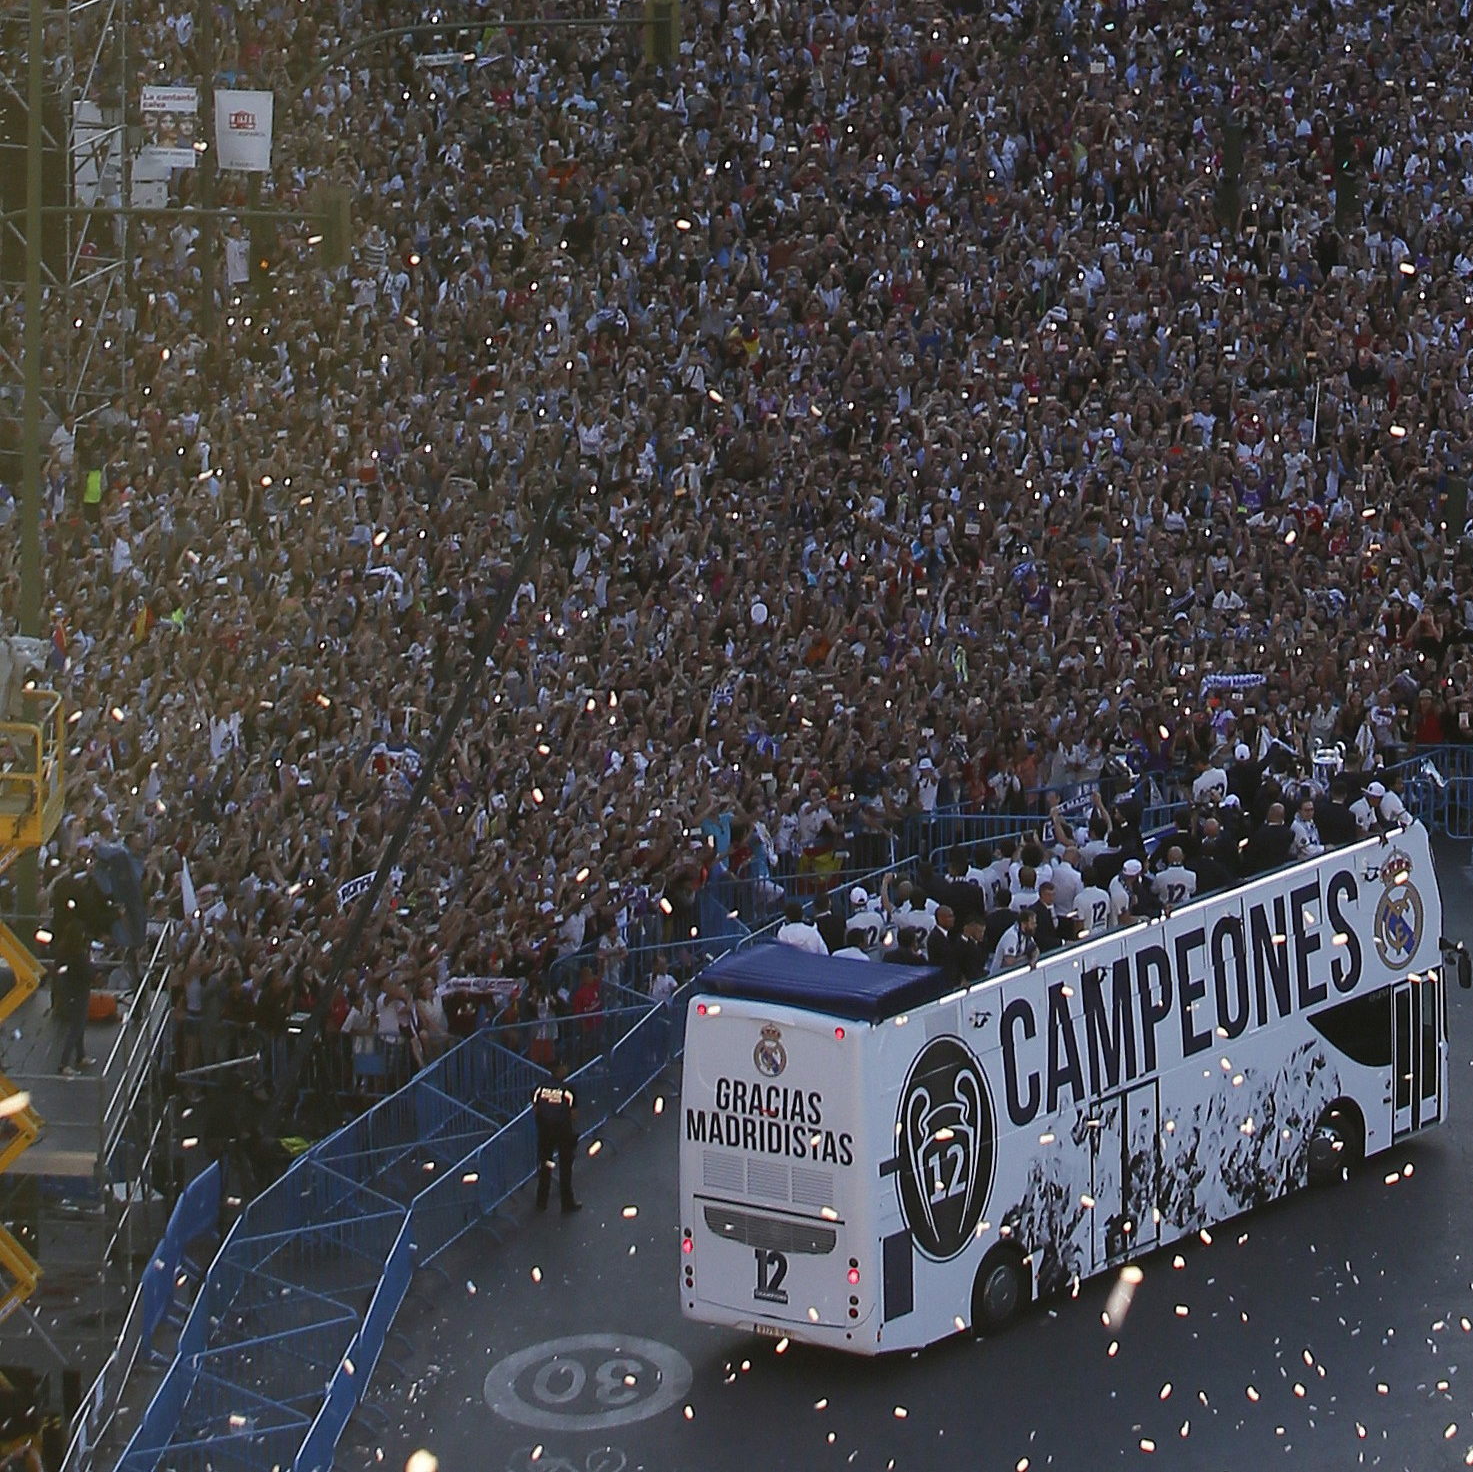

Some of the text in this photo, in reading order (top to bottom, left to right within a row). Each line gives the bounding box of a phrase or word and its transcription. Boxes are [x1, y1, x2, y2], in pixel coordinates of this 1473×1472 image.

[143, 93, 197, 102] La cantante
[1092, 900, 1106, 924] 12
[1000, 870, 1362, 1126] CAMPEONES
[715, 1077, 822, 1125] GRACIAS
[686, 1108, 853, 1166] MADRIDISTAS
[928, 1143, 967, 1205] 12
[754, 1248, 789, 1292] 12
